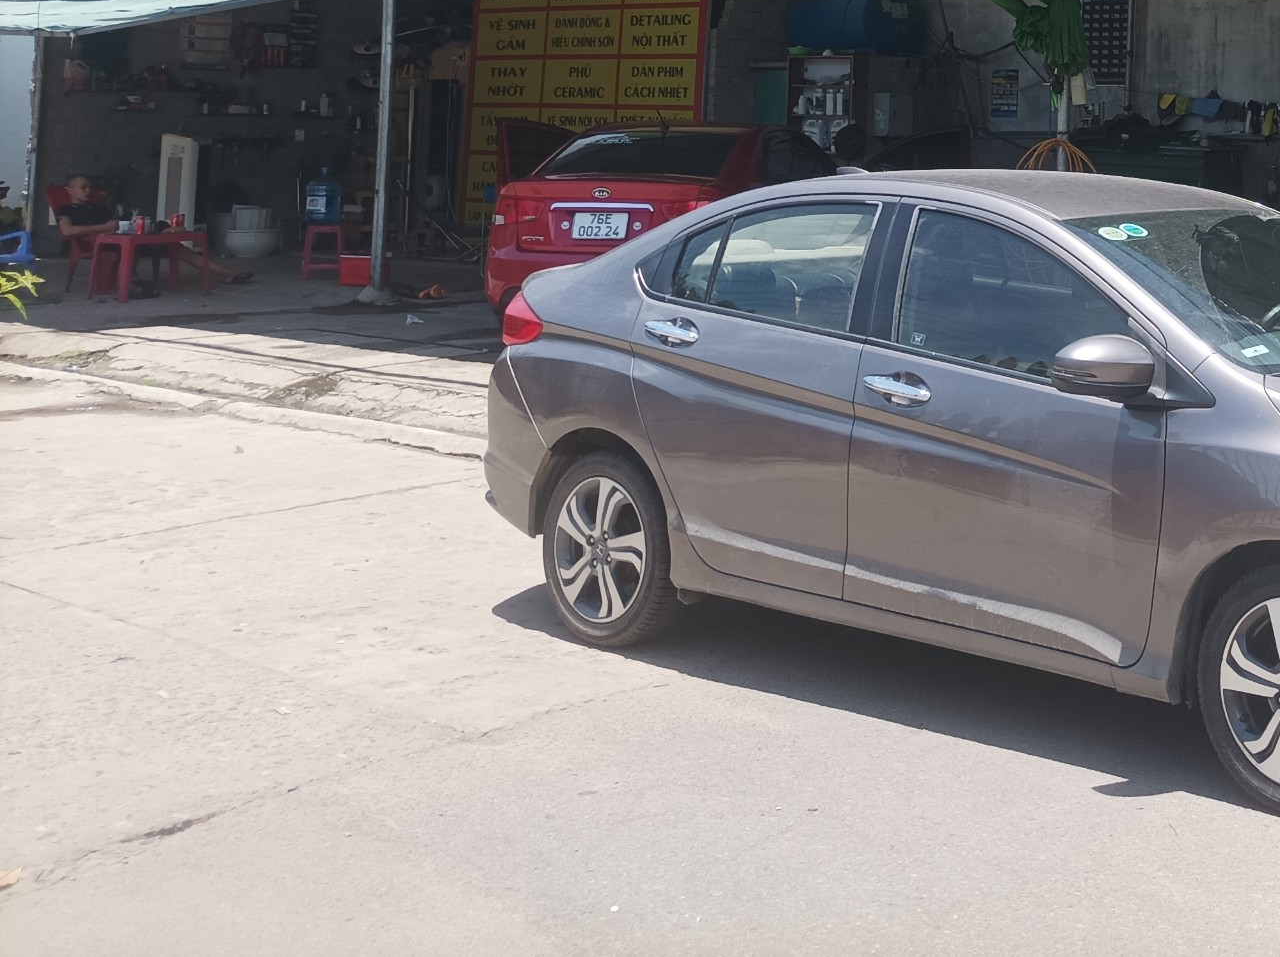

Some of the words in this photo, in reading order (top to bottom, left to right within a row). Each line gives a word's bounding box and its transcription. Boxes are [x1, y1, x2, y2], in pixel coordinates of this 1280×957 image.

[489, 17, 503, 34] VỆ
[507, 18, 537, 30] SINH
[555, 14, 578, 28] ĐÁNH
[579, 13, 603, 28] BÓNG
[604, 17, 611, 27] &
[630, 13, 692, 27] DETAILING
[551, 35, 570, 50] HIỆU
[571, 32, 596, 48] CHỈNH
[598, 35, 614, 48] SƠN
[631, 32, 652, 50] NỘI
[656, 30, 687, 47] THẤT
[489, 66, 528, 78] THAY
[569, 62, 592, 78] PHỦ
[631, 62, 655, 78] DÁN
[657, 66, 684, 78] PHIM
[488, 82, 526, 97] NHỚT
[553, 87, 605, 99] CERAMIC
[624, 83, 655, 98] CÁCH
[657, 84, 689, 101] NHIỆT
[559, 115, 577, 127] SINH
[590, 213, 613, 225] 76E
[578, 225, 620, 237] 002.24
